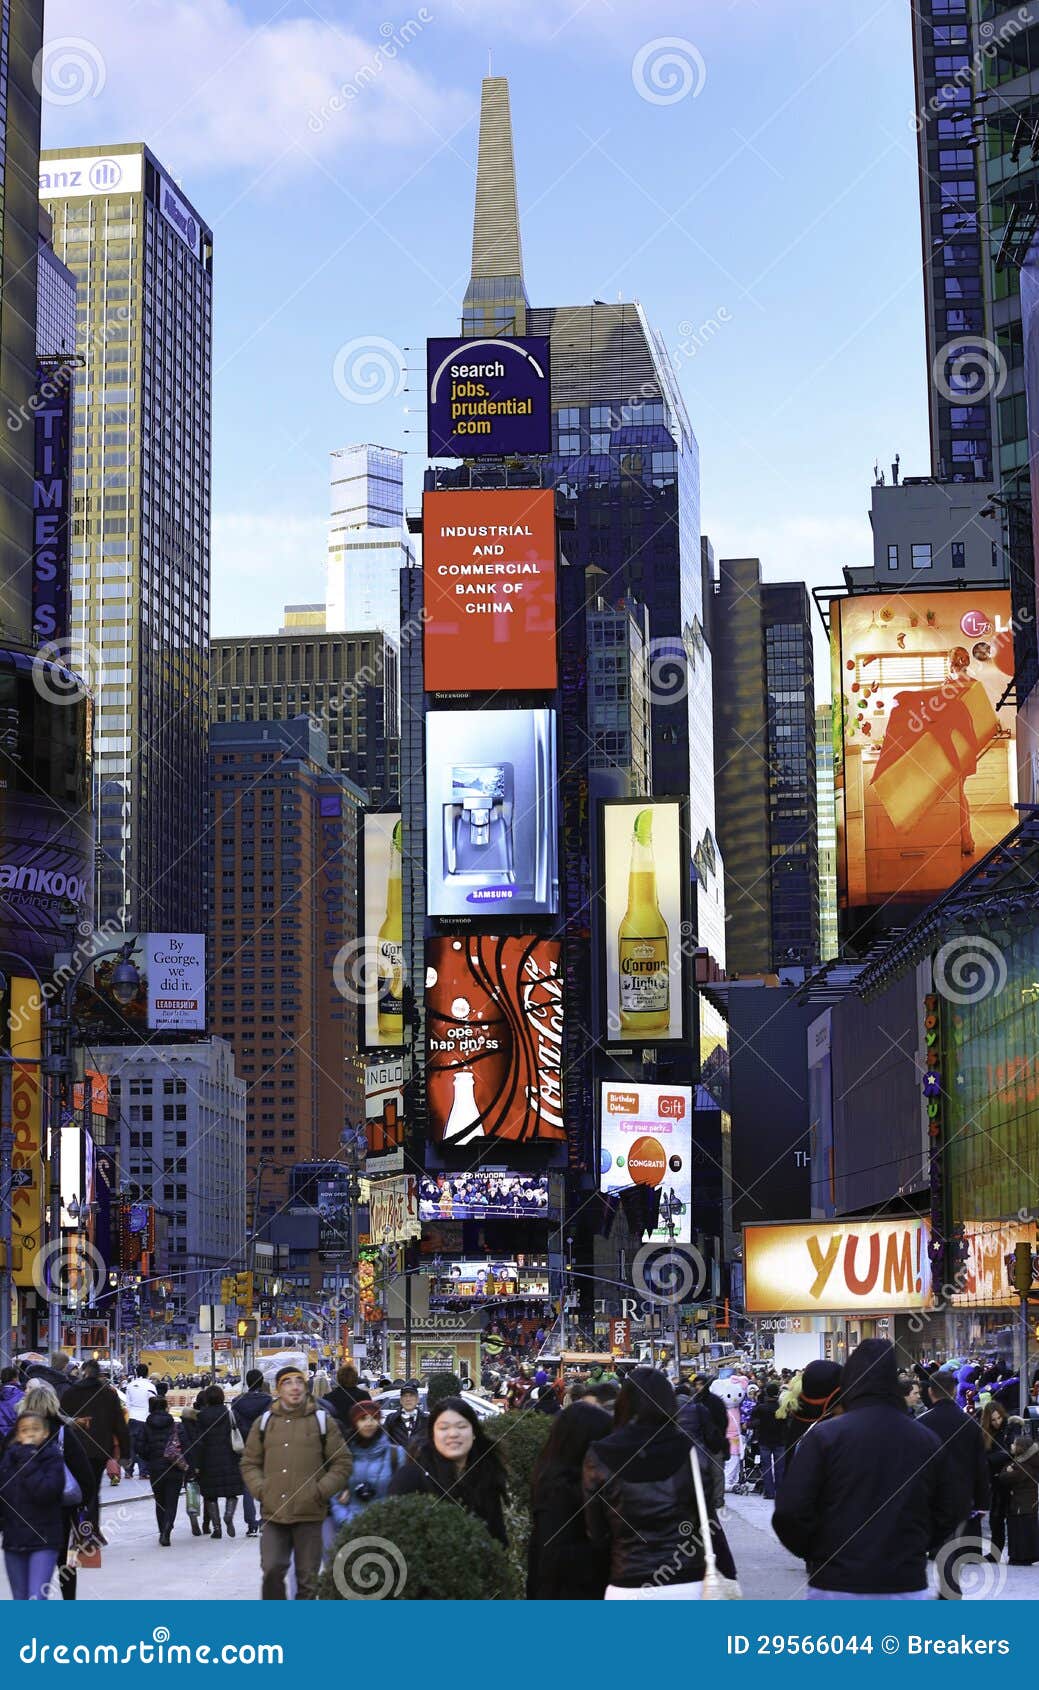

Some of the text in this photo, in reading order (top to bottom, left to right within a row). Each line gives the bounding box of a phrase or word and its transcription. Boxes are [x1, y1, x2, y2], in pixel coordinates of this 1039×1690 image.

[451, 361, 504, 378] search
[451, 381, 490, 400] jobs.
[452, 399, 532, 418] prudential
[452, 420, 491, 434] .com
[32, 409, 62, 581] TIMES
[441, 526, 533, 537] INDUSTRIAL
[472, 545, 504, 556] AND
[438, 563, 540, 576] COMMERCIAL
[455, 583, 523, 595] BANK OF
[465, 603, 513, 614] CHINA
[472, 890, 513, 899] SAMSUNG
[169, 939, 184, 953] By
[153, 952, 200, 966] George,
[168, 968, 185, 977] we
[160, 978, 192, 991] did it.
[156, 1000, 195, 1009] LEADERSHIP
[610, 1094, 683, 1115] Birthday Gift
[628, 1159, 665, 1168] CONGRATS!
[806, 1228, 922, 1300] YUM!
[614, 1320, 627, 1345] tkts
